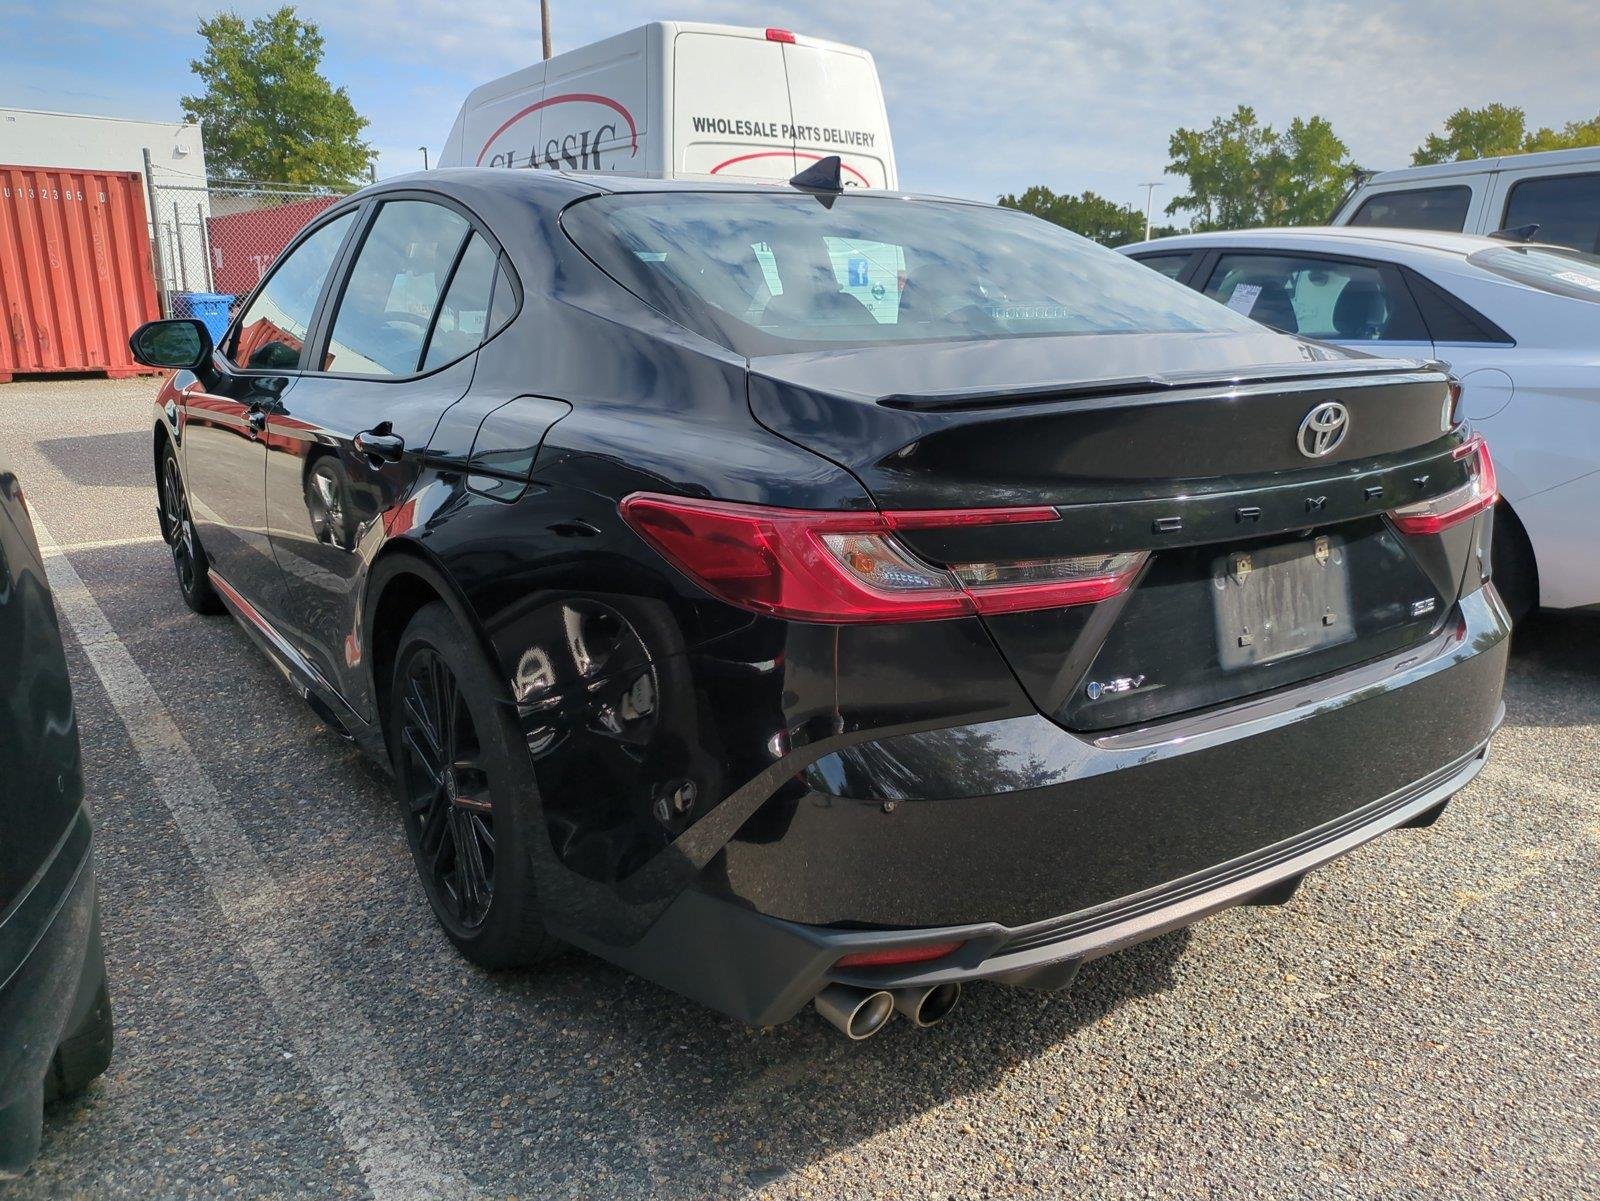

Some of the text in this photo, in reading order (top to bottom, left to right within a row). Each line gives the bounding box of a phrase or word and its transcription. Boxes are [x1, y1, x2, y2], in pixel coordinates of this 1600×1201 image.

[692, 116, 875, 148] WHOLESALE PARTS DELIVERY
[1152, 475, 1430, 534] CAMRY
[1100, 675, 1146, 694] HEV
